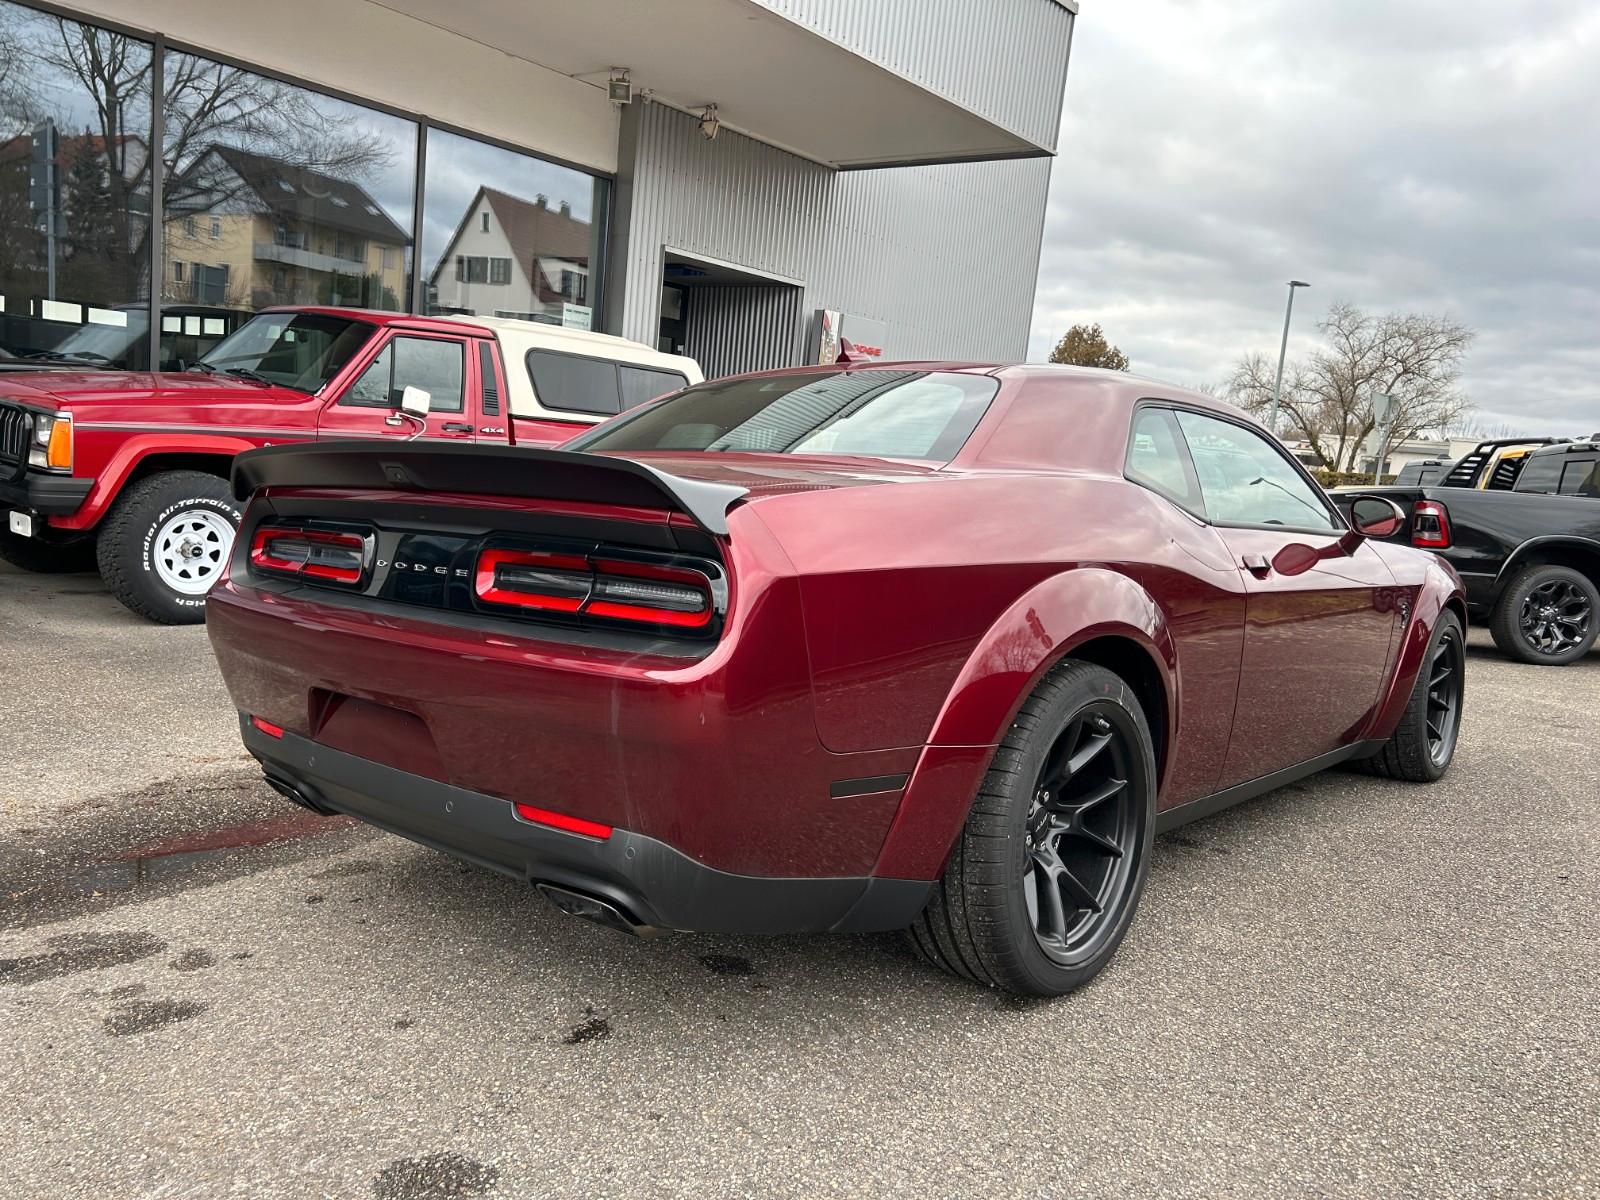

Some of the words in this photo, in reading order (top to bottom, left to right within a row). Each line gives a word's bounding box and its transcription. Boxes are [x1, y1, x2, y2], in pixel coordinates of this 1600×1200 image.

[854, 344, 882, 356] ODGE
[143, 522, 158, 571] Radial
[159, 498, 231, 522] All-Terrain
[376, 559, 469, 577] DODGE
[175, 597, 206, 607] rich
